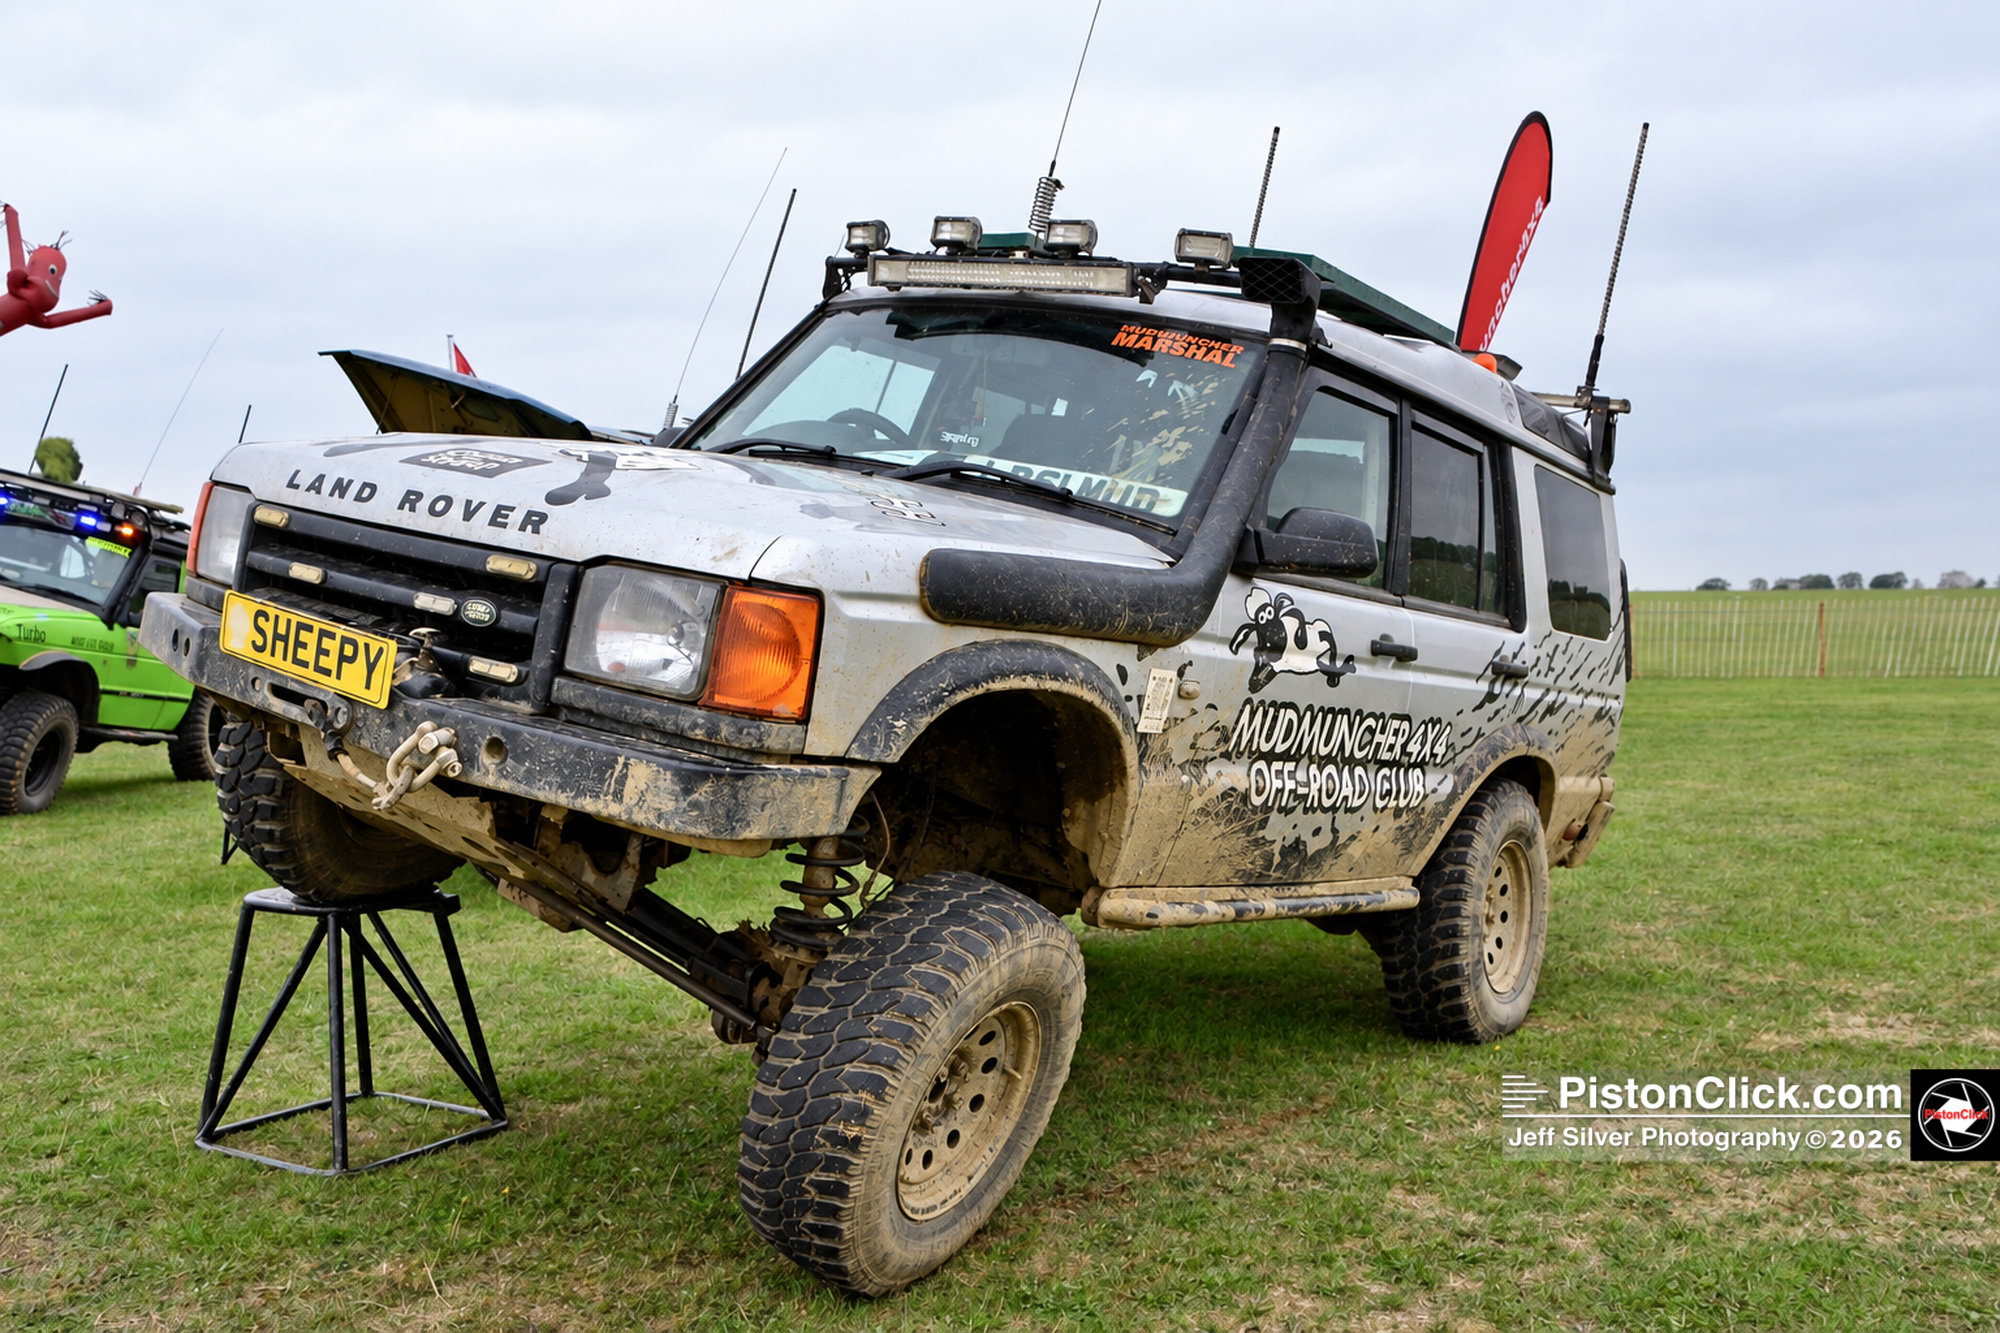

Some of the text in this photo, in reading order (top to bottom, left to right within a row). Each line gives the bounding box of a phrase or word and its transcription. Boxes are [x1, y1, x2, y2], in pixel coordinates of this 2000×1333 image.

[1111, 332, 1236, 369] MARSHAL
[286, 469, 549, 534] LAND ROVER
[16, 623, 47, 643] Turbo
[251, 609, 384, 691] SHEEPY
[1228, 704, 1410, 762] MUDMUNCHER
[1250, 759, 1425, 809] OFF-ROAD CLUB
